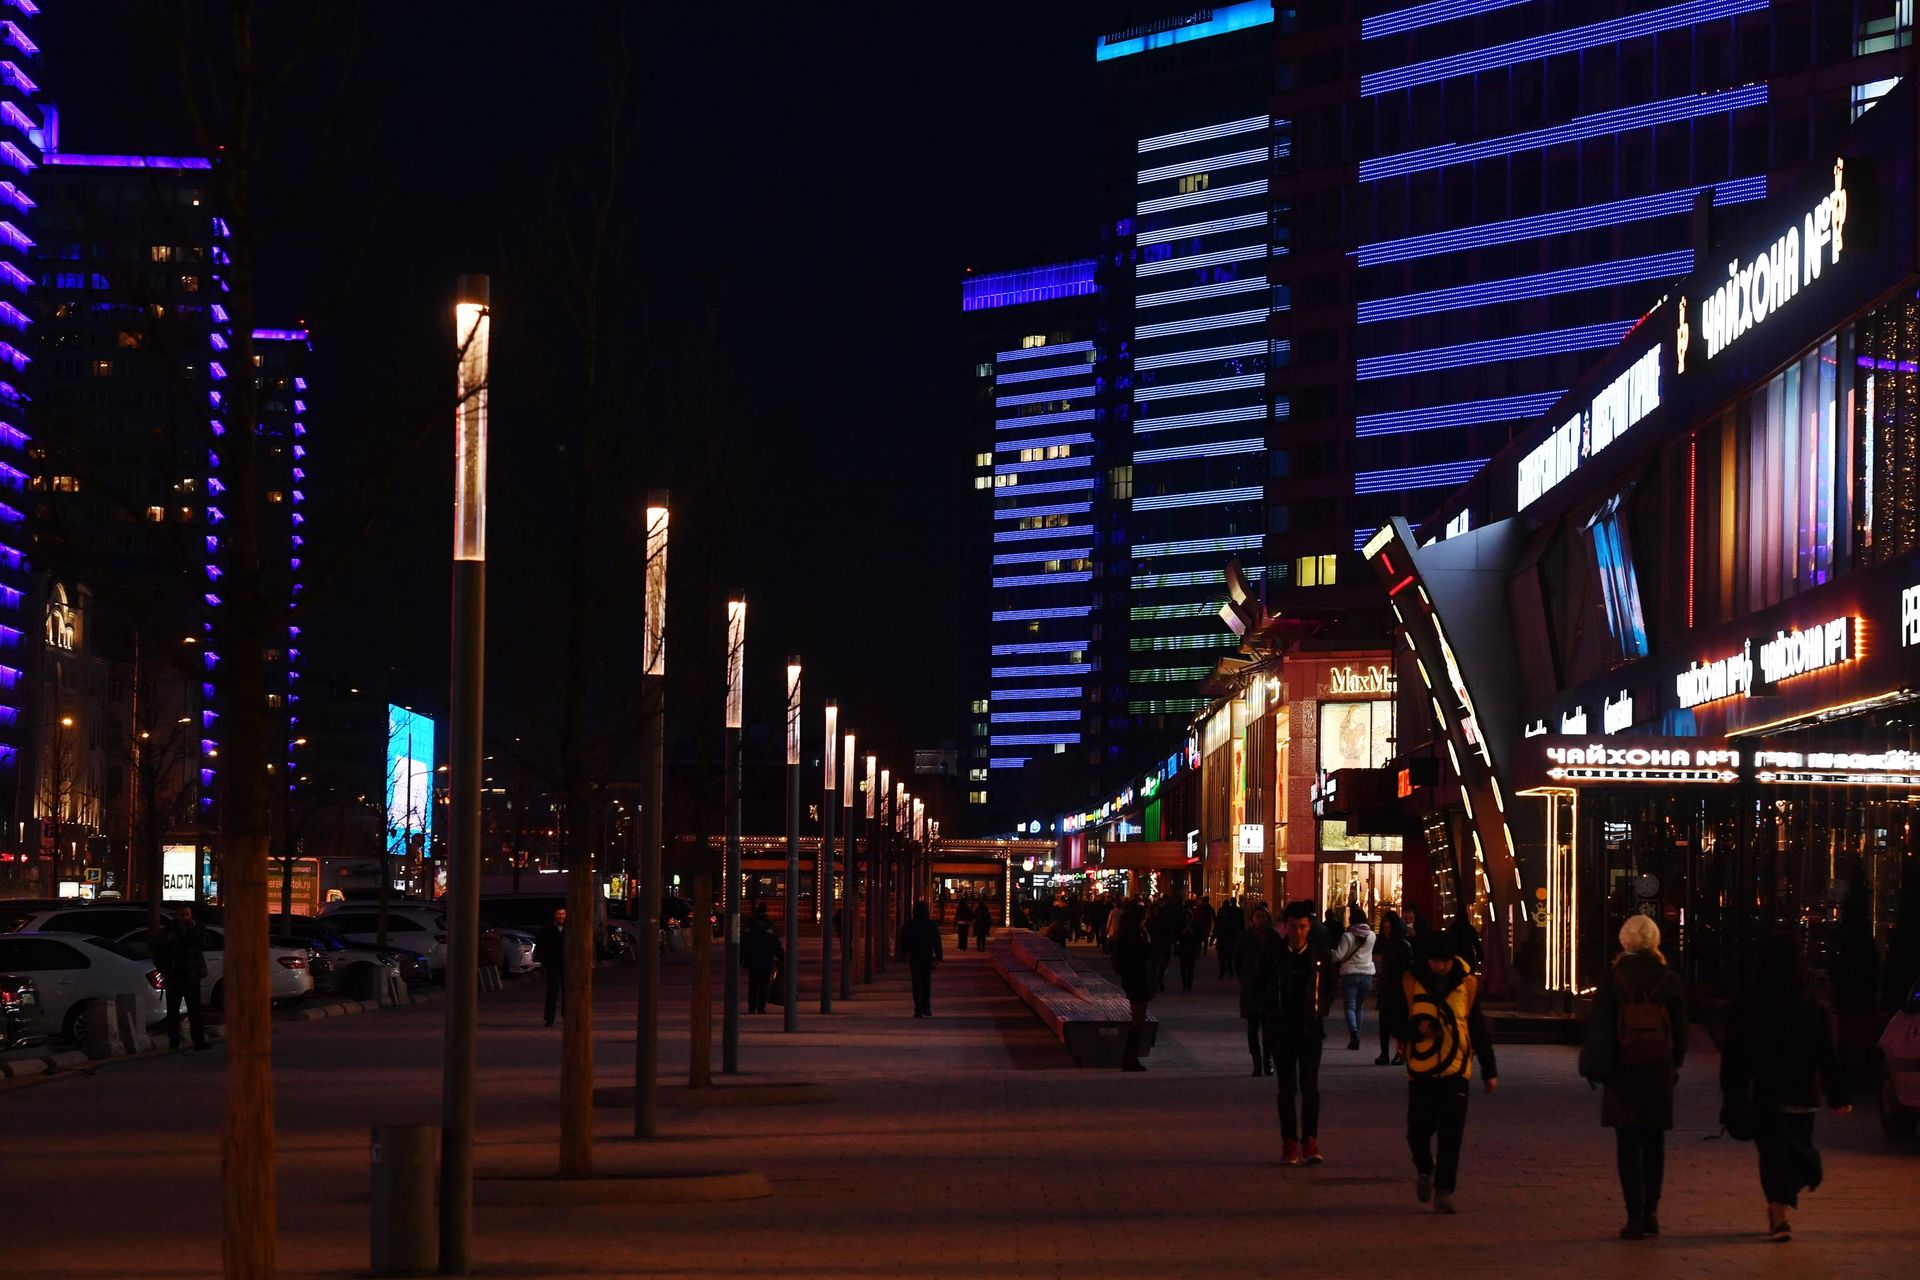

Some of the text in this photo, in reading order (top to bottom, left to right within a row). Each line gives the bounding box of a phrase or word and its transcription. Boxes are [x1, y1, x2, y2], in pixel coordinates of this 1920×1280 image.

[1702, 226, 1799, 360] ЧАЙХОНА
[1761, 625, 1823, 683] ЧАЙХОНА
[1546, 743, 1690, 766] ЧАЙХОНА
[163, 874, 194, 889] БАСТА
